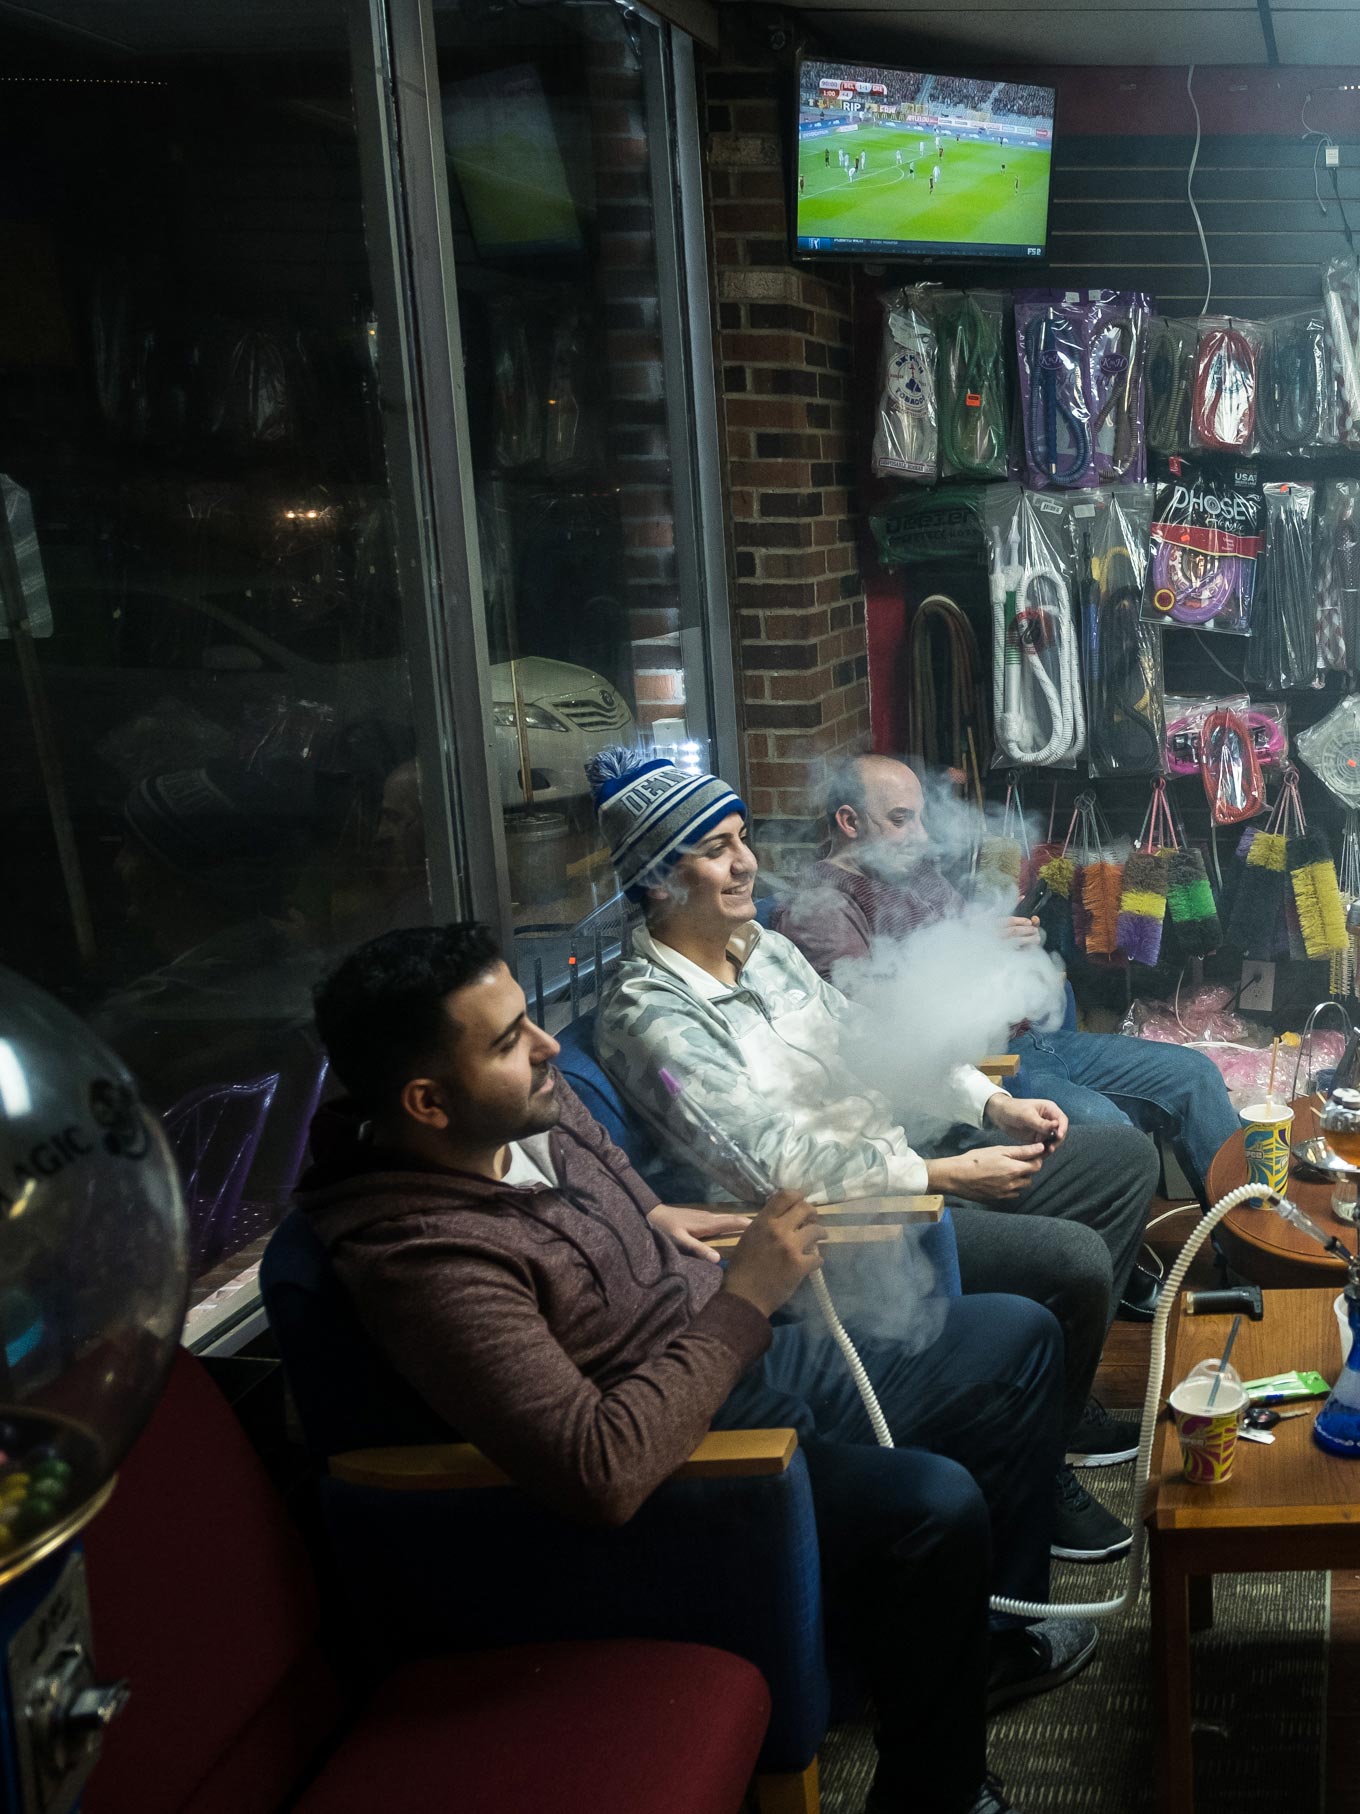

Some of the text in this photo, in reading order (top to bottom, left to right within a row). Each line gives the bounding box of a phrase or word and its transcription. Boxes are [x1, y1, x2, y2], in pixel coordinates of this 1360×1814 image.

[843, 101, 861, 112] RIP
[1234, 472, 1255, 482] USA
[1173, 485, 1247, 521] PHOSE
